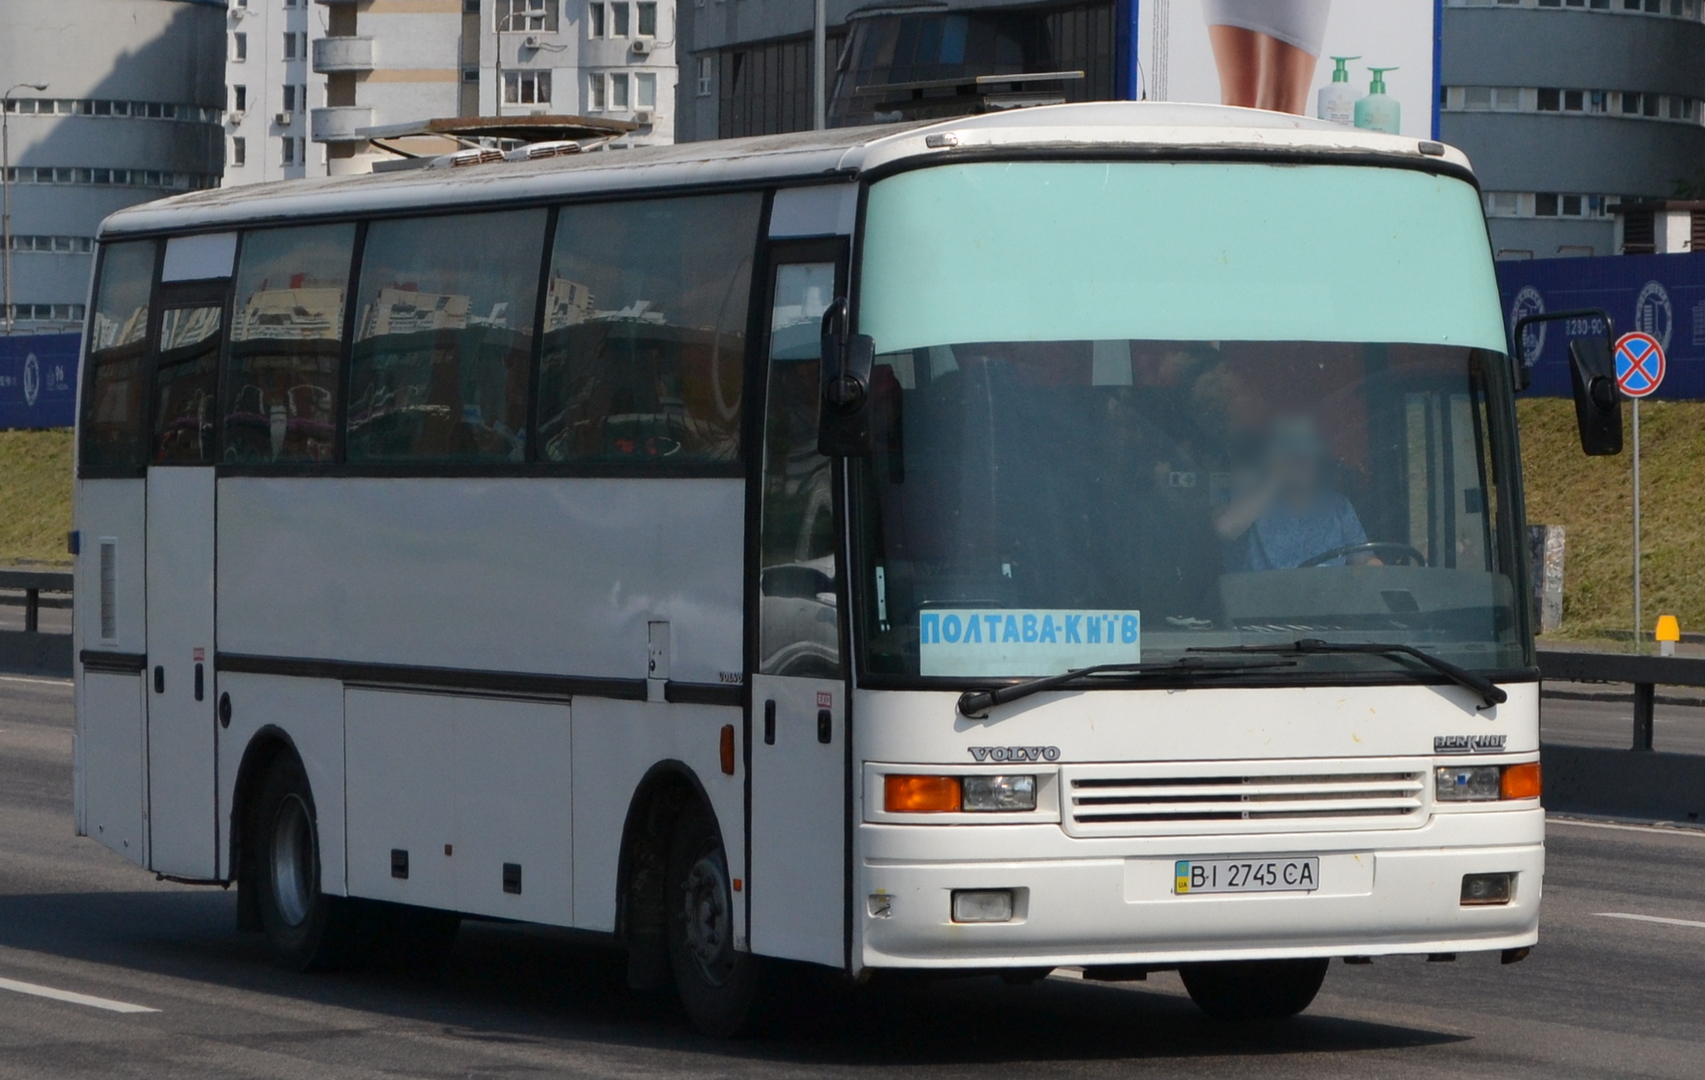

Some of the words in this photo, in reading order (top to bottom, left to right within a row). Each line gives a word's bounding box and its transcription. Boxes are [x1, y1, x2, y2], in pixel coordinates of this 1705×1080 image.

[1434, 735, 1507, 752] BERKHOF
[967, 745, 1061, 761] VOLVO
[1228, 863, 1276, 886] 2745
[1283, 862, 1313, 885] CA
